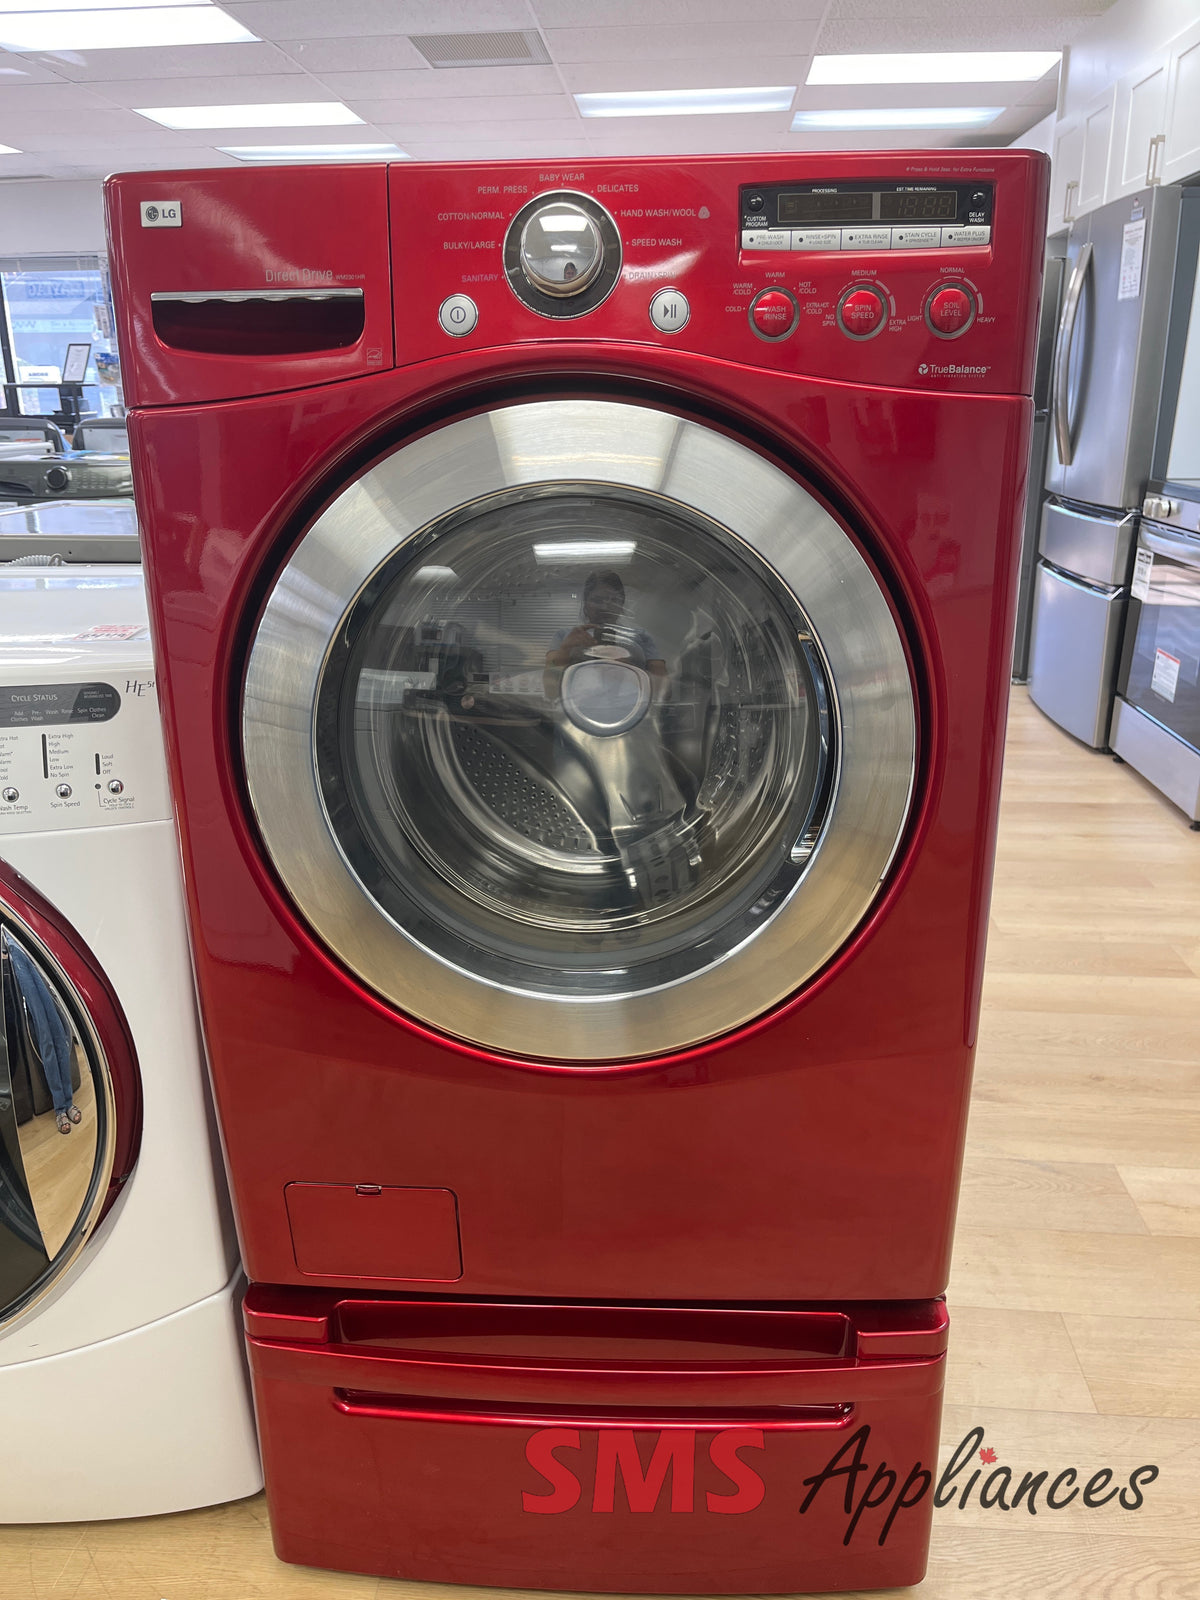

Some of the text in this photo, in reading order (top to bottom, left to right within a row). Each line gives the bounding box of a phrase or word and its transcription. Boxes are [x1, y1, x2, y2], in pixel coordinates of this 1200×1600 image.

[539, 173, 585, 182] BABY WEAR
[477, 186, 528, 194] PERM. PRESS
[597, 184, 639, 193] DELICATES
[162, 208, 177, 219] LG
[437, 211, 505, 221] COTTON/NORMAL
[621, 208, 696, 217] HAND WASH/WOOL
[443, 240, 496, 250] BULKY/LARGE
[631, 238, 682, 247] SPEED WASH
[265, 268, 299, 282] Direct
[302, 268, 333, 281] Drive
[461, 273, 498, 282] SANITARY
[851, 311, 875, 319] SPEED
[940, 309, 962, 317] LEVEL
